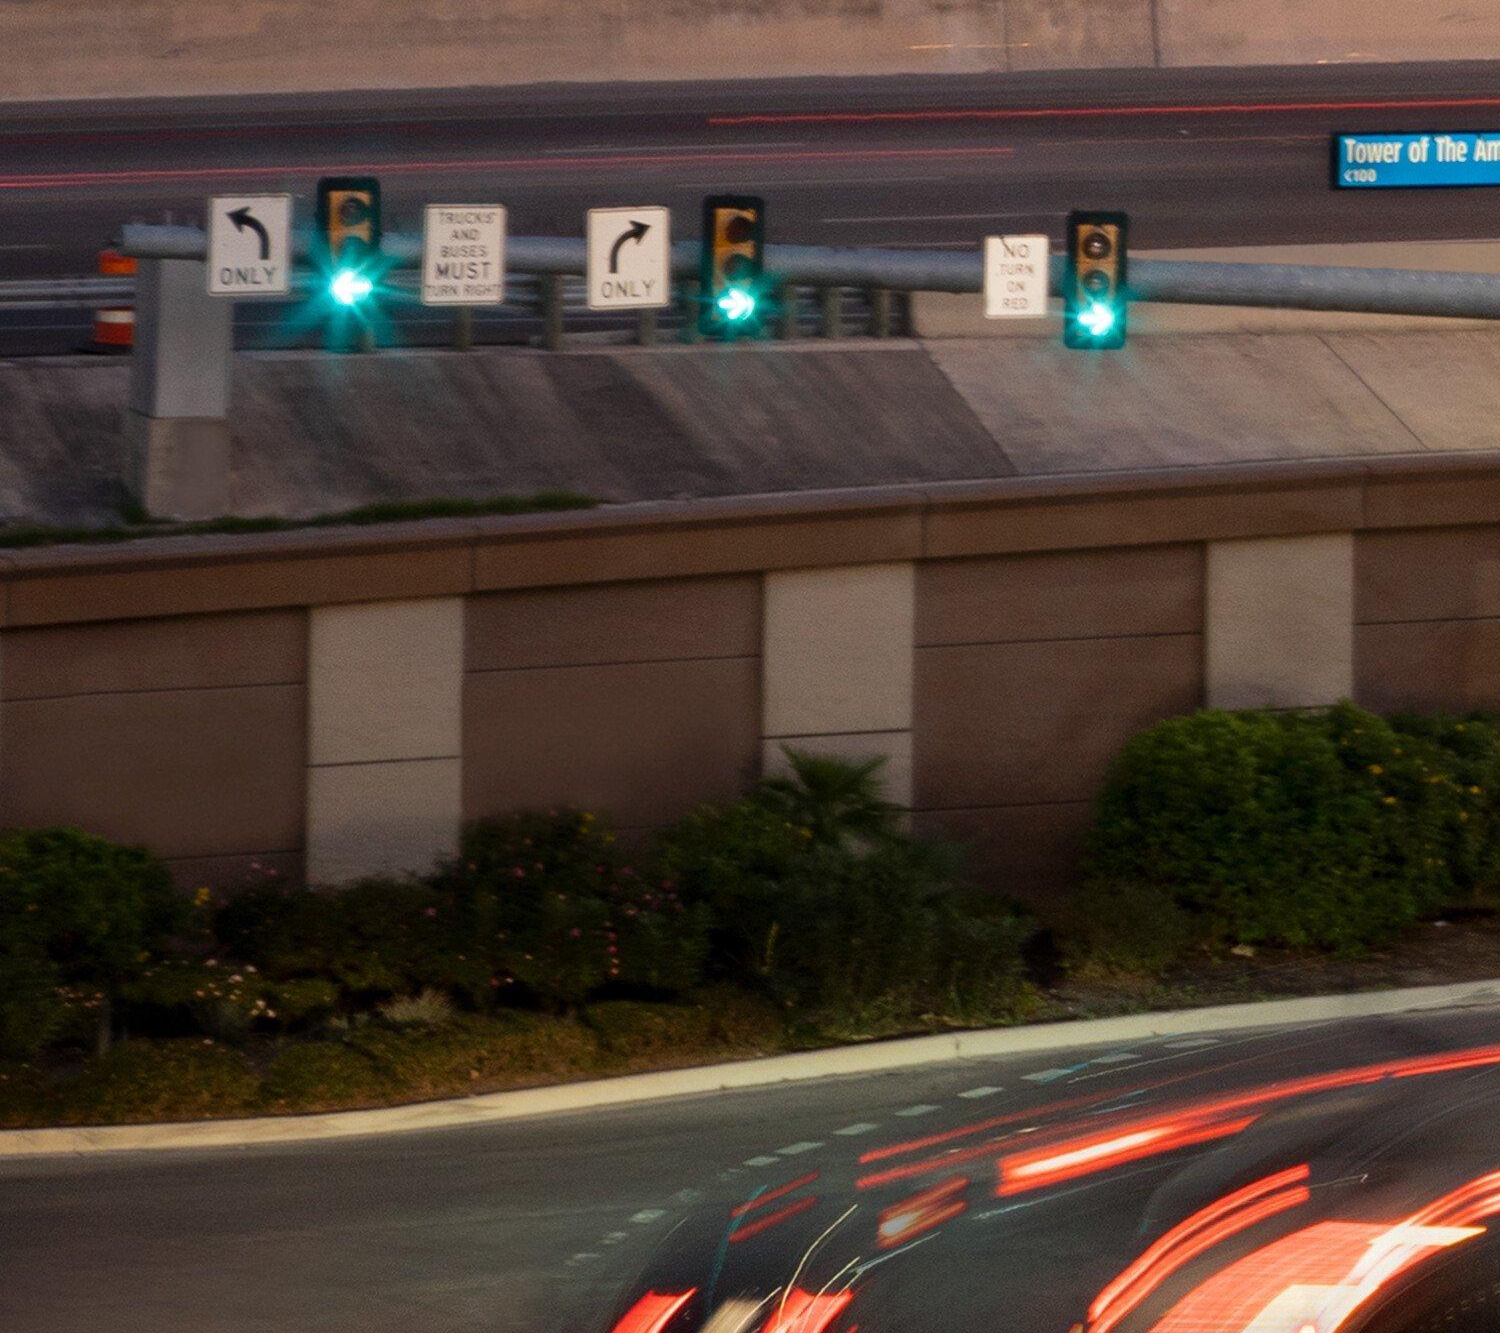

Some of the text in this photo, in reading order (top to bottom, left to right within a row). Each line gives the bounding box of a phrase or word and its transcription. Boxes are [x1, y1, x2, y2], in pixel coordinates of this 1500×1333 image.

[1344, 137, 1403, 164] Tower
[1407, 136, 1430, 164] of
[1434, 135, 1468, 163] The
[451, 228, 481, 241] AND
[441, 245, 488, 258] BUSES
[1003, 243, 1030, 259] NO
[220, 266, 277, 286] ONLY
[435, 261, 492, 280] MUST
[999, 262, 1036, 277] TURN
[601, 279, 656, 299] ONLY
[1006, 279, 1025, 293] ON
[1002, 297, 1030, 310] RED
